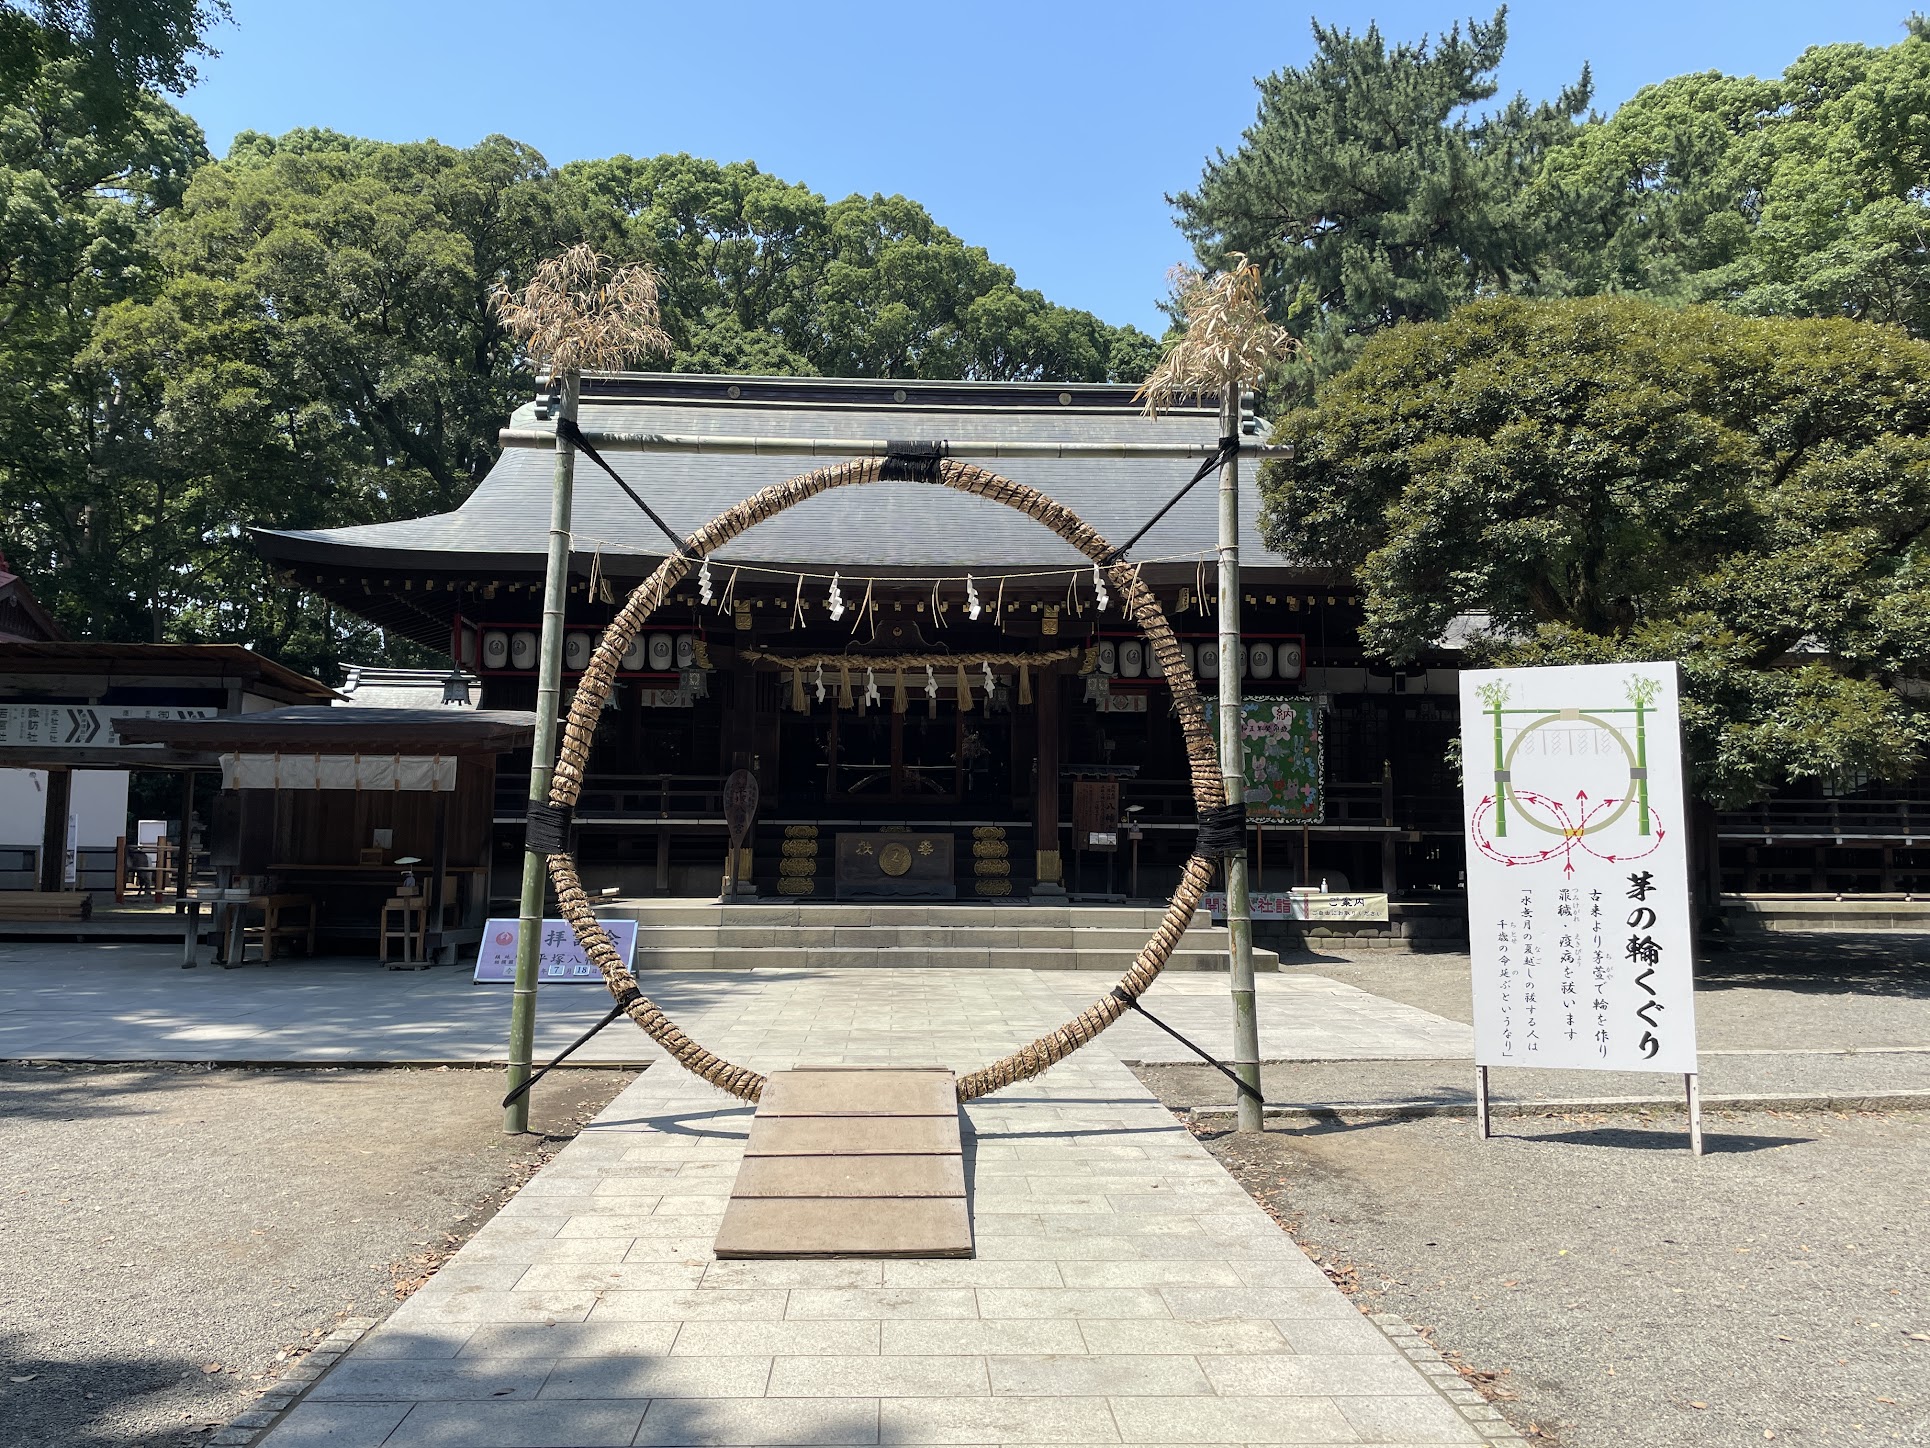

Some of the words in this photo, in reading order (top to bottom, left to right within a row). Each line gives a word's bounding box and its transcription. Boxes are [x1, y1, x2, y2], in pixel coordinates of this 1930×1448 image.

[1205, 898, 1291, 914] 開社詣
[1329, 897, 1365, 907] ご案内
[1588, 888, 1610, 1059] 古来より茅萱で輪を作り
[1624, 870, 1665, 1060] 茅の輪くぐり
